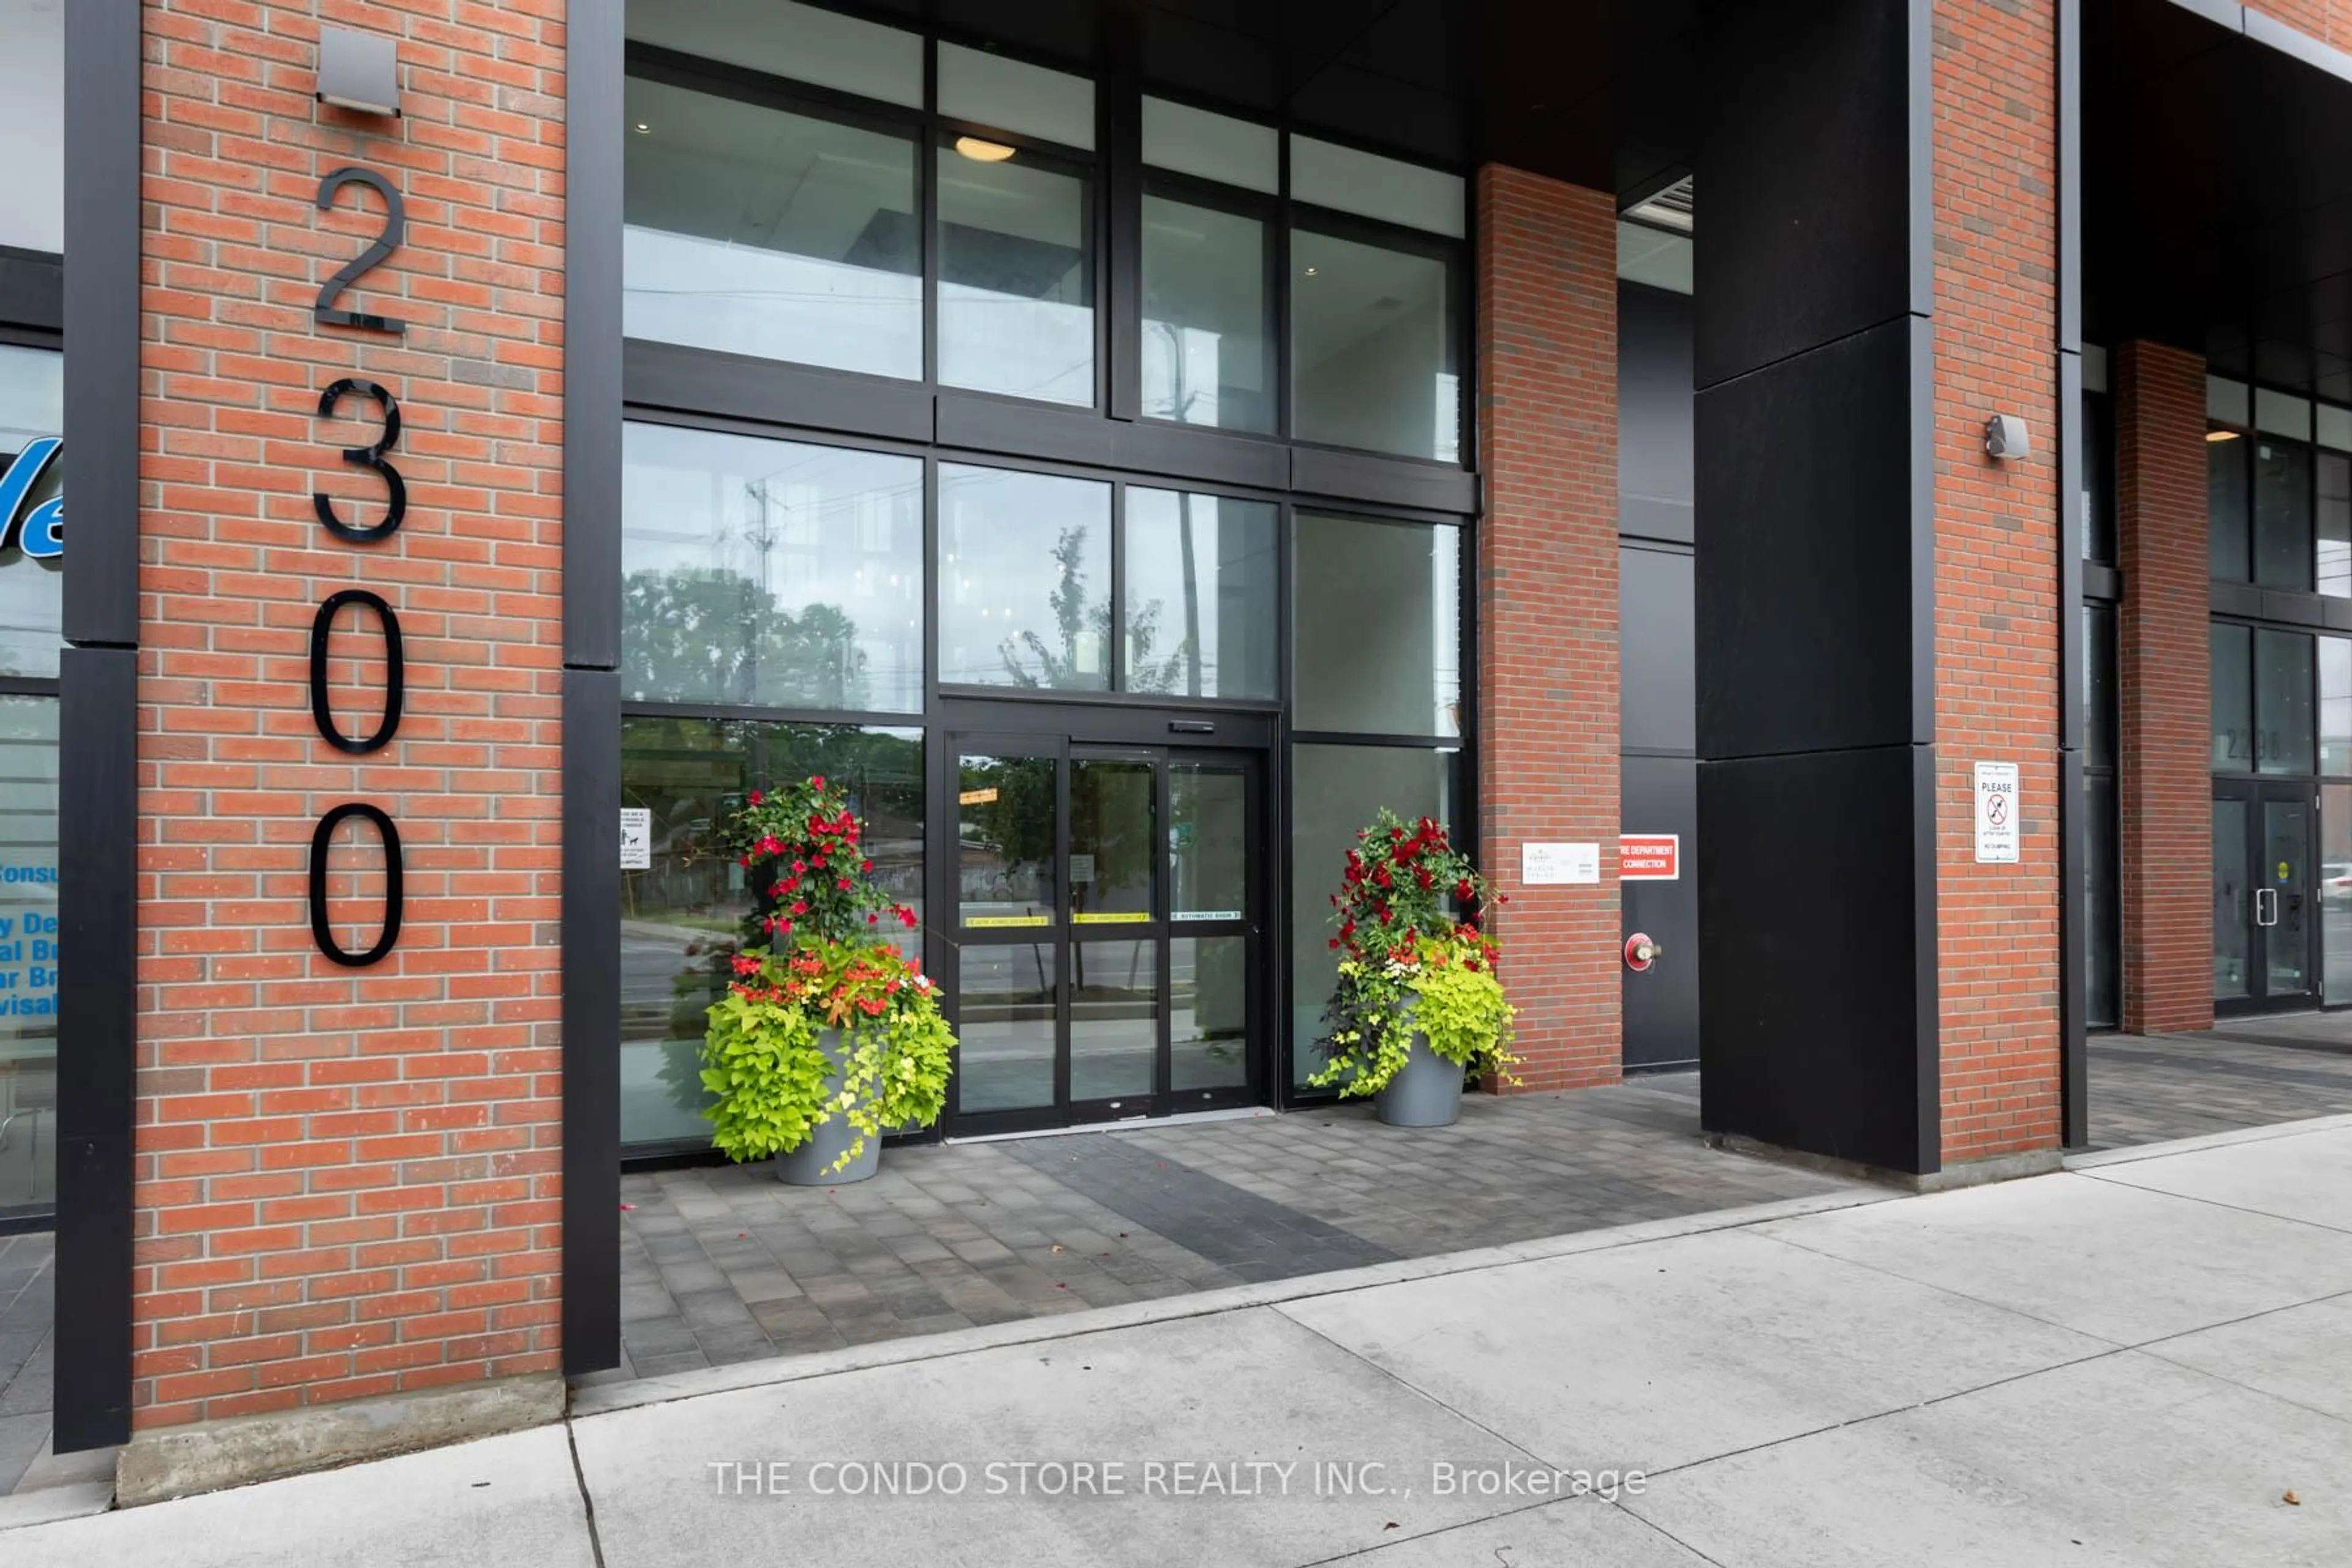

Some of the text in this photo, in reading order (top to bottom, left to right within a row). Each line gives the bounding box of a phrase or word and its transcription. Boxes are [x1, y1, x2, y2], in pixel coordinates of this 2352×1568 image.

[308, 167, 407, 970] 2300
[1981, 782, 2012, 793] PLEASE
[1630, 845, 1673, 855] DEPARTMENT
[1623, 859, 1667, 869] CONNECTION
